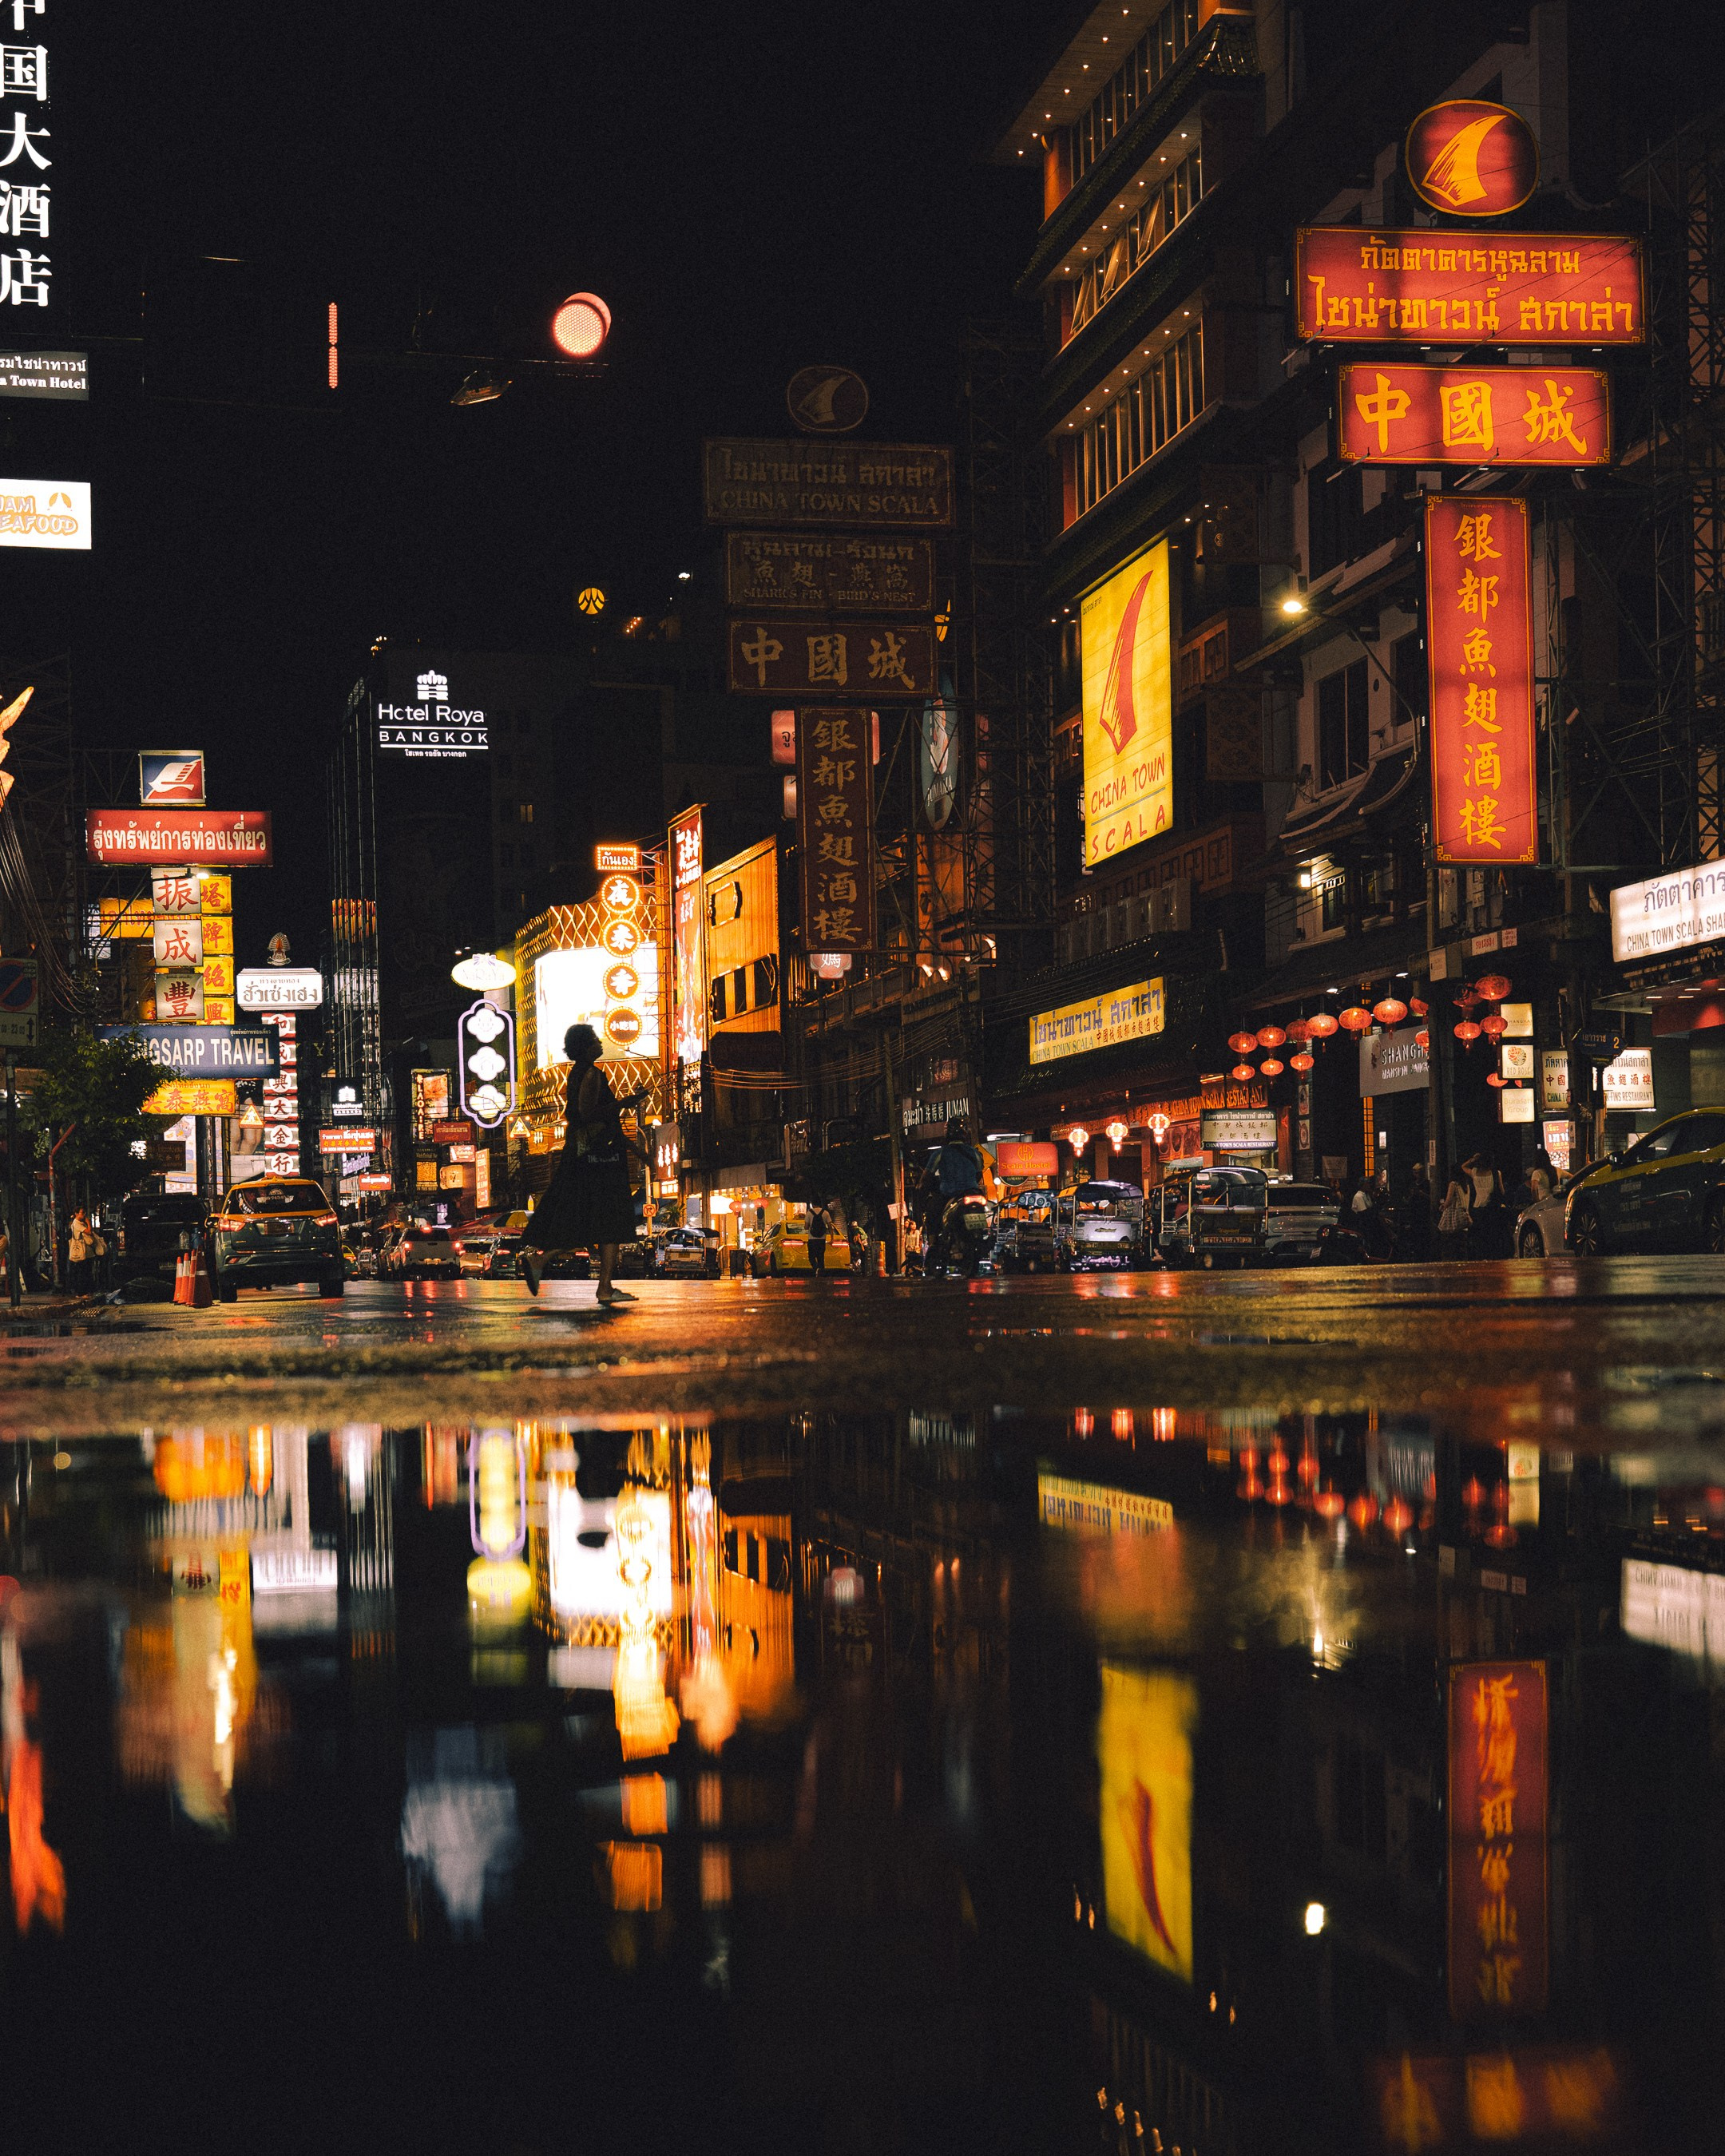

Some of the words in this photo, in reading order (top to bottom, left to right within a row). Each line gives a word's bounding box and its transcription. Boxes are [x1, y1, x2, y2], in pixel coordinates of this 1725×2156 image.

[1308, 275, 1500, 331] ไชน่าทาวน์
[1519, 287, 1636, 333] สกาล่า
[10, 375, 47, 388] Town
[50, 377, 86, 389] Hotel
[1355, 372, 1588, 456] 中國城
[720, 489, 789, 510] CHINA
[795, 493, 861, 513] TOWN
[867, 494, 940, 515] SCALA
[741, 626, 915, 691] 中國城
[1453, 513, 1507, 850] 銀都魚翅酒樓
[436, 704, 485, 727] Roya
[379, 731, 488, 743] BANGKOK
[1091, 775, 1128, 815] CHINA
[1133, 752, 1166, 791] TOWN
[93, 814, 267, 861] รุ่งทรัพย์การท่องเที่ยว
[812, 719, 862, 943] 銀都魚翅酒樓
[1092, 804, 1166, 860] SCALA
[602, 851, 634, 866] กันเอง
[1627, 933, 1650, 953] CHINA
[1652, 925, 1674, 947] TOWN
[1676, 918, 1703, 940] SCALA
[1032, 998, 1104, 1045] ไชน่าทาวน์
[1110, 980, 1161, 1025] สกาล่า
[211, 1038, 275, 1065] TRAVEL
[1033, 1047, 1050, 1063] CHINA
[1053, 1041, 1071, 1057] TOWN
[1073, 1036, 1094, 1053] SCALA
[1382, 1043, 1429, 1065] SHANGH
[1613, 1036, 1620, 1049] 2
[1507, 1067, 1516, 1076] RED
[1518, 1067, 1530, 1076] ROSE
[1205, 1092, 1224, 1110] SCALA
[1226, 1085, 1263, 1107] RESTAUANT
[1548, 1092, 1562, 1103] CHINA
[1622, 1091, 1652, 1102] RESTAURANT
